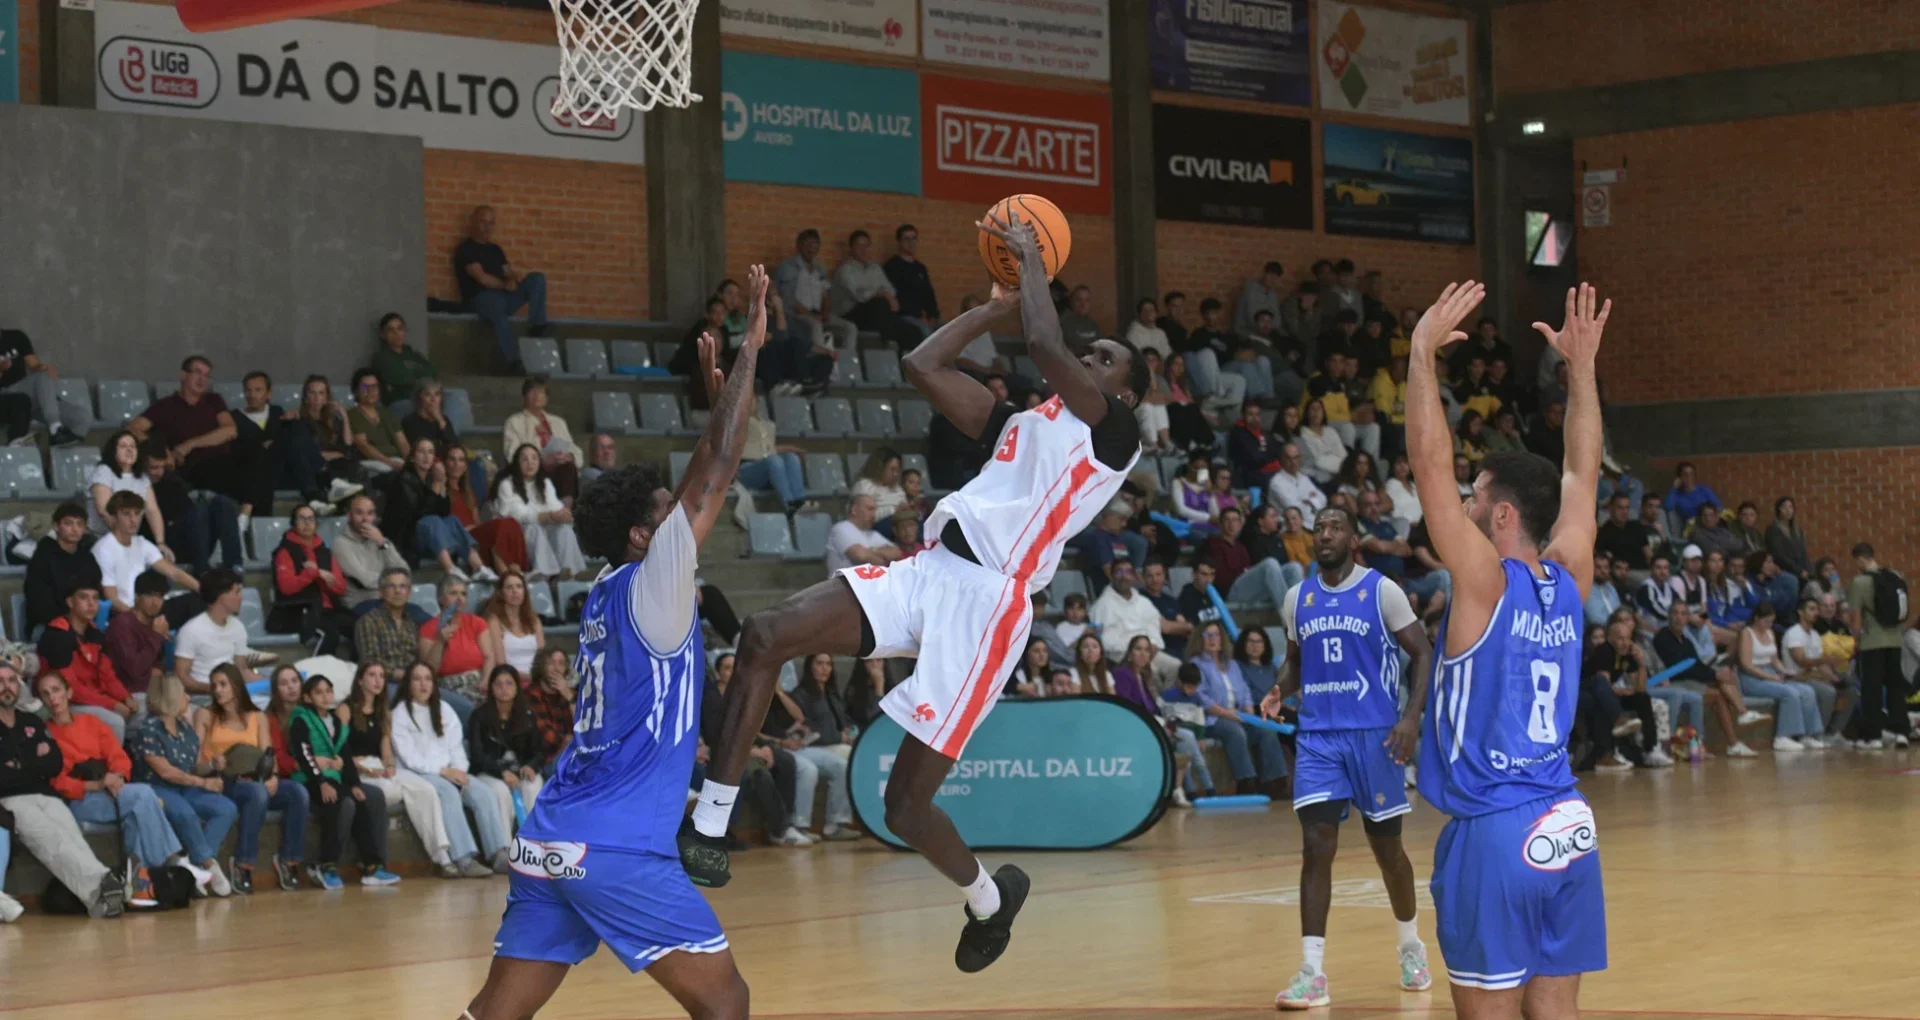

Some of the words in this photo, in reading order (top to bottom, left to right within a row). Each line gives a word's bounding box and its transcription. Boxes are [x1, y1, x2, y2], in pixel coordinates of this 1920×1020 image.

[237, 40, 310, 101] DÁ
[325, 60, 360, 104] O
[373, 65, 519, 119] SALTO
[752, 102, 844, 132] HOSPITAL
[846, 111, 873, 134] DA
[877, 114, 912, 137] LUZ
[754, 131, 793, 146] AVEIRO
[944, 117, 1093, 173] PIZZARTE
[1168, 155, 1270, 185] CIVILRIA
[995, 425, 1019, 463] 9
[1298, 615, 1371, 641] SANGALHOS
[1321, 637, 1343, 663] 13
[573, 651, 606, 733] 21
[1304, 680, 1360, 694] BOOMERANG
[1527, 658, 1560, 744] 8
[1046, 758, 1080, 777] DA
[1086, 757, 1132, 777] LUZ
